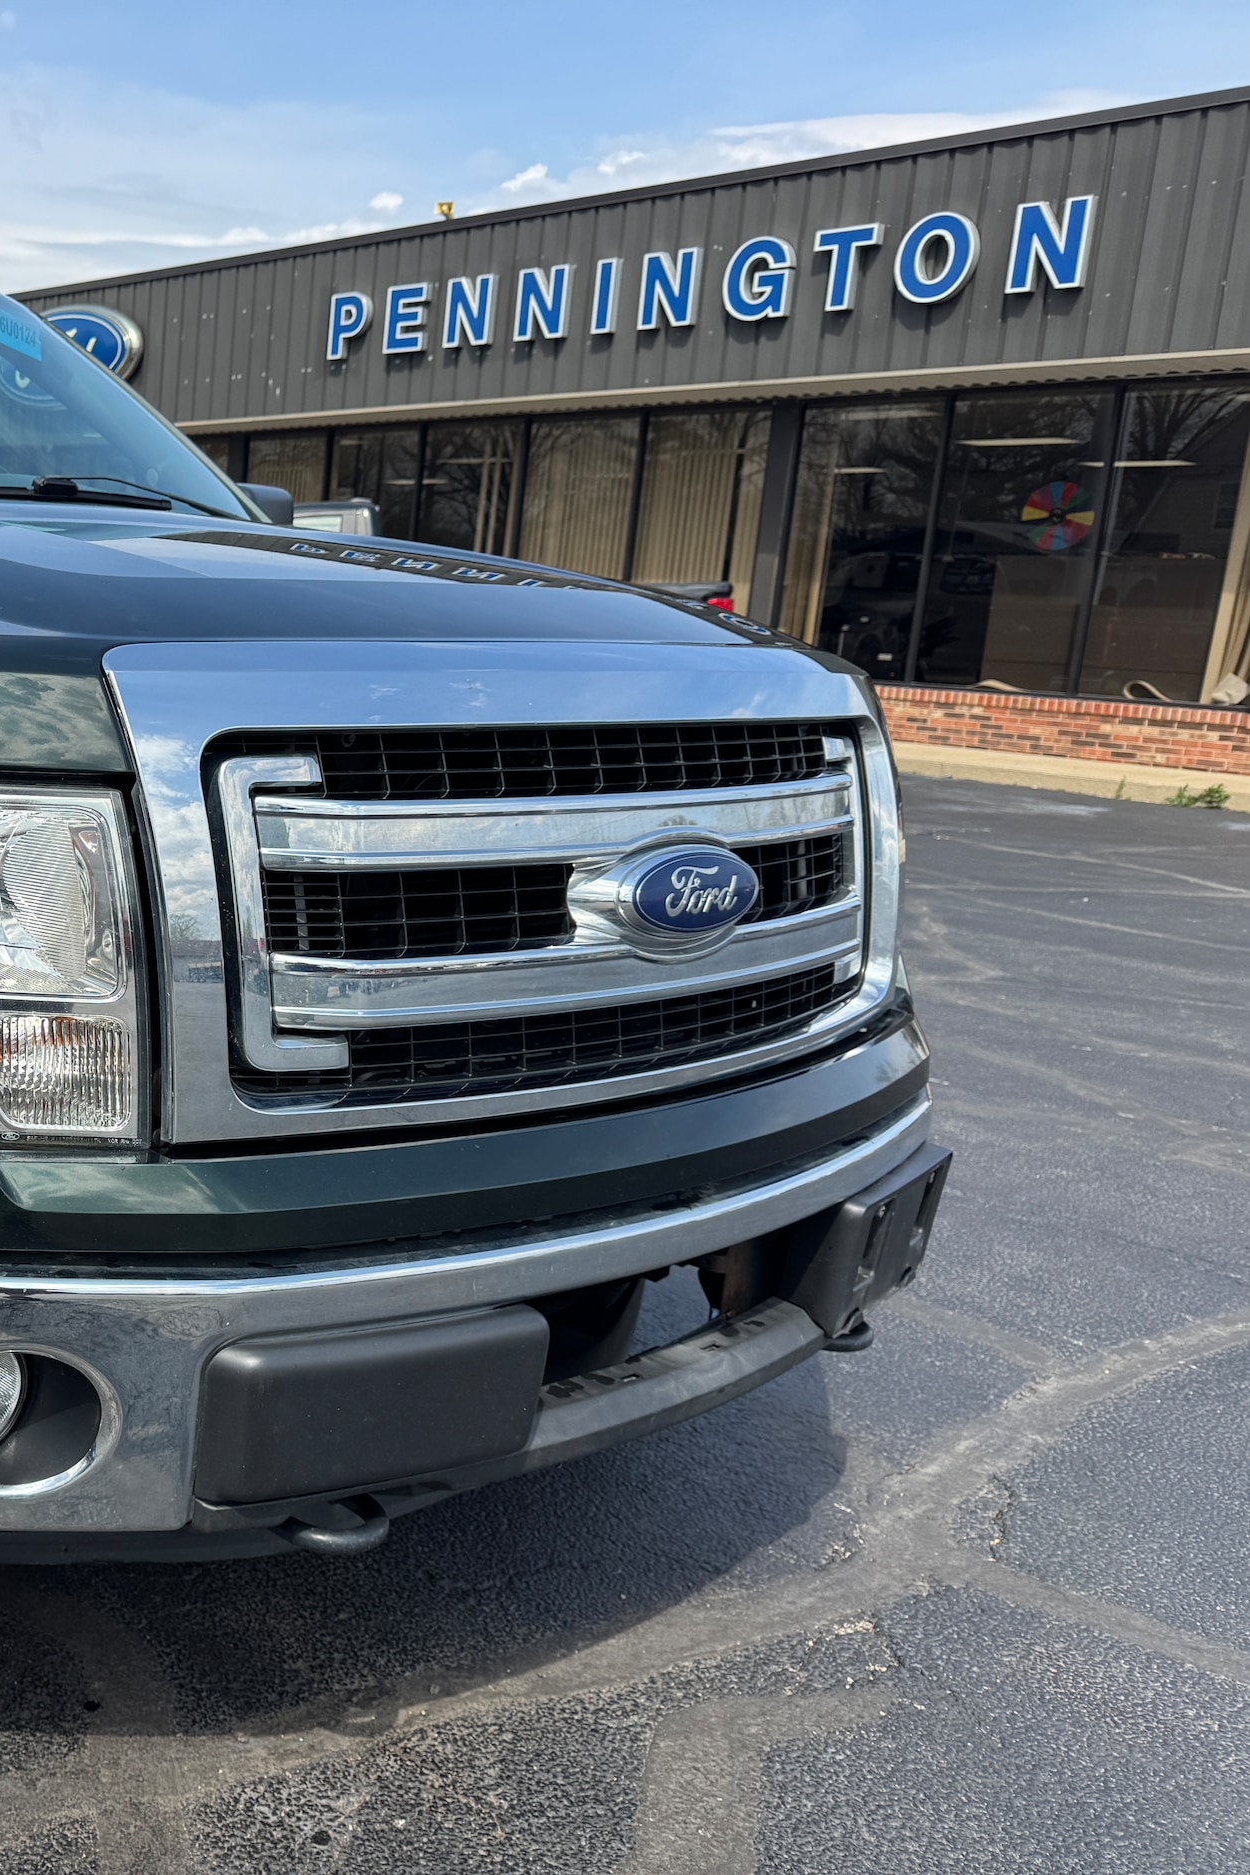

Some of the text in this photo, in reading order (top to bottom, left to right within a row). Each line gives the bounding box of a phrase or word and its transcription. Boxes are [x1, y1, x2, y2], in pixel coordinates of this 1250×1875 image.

[326, 194, 1097, 361] PENNINGTON
[0, 316, 36, 348] 6U0124
[665, 865, 738, 917] Ford
